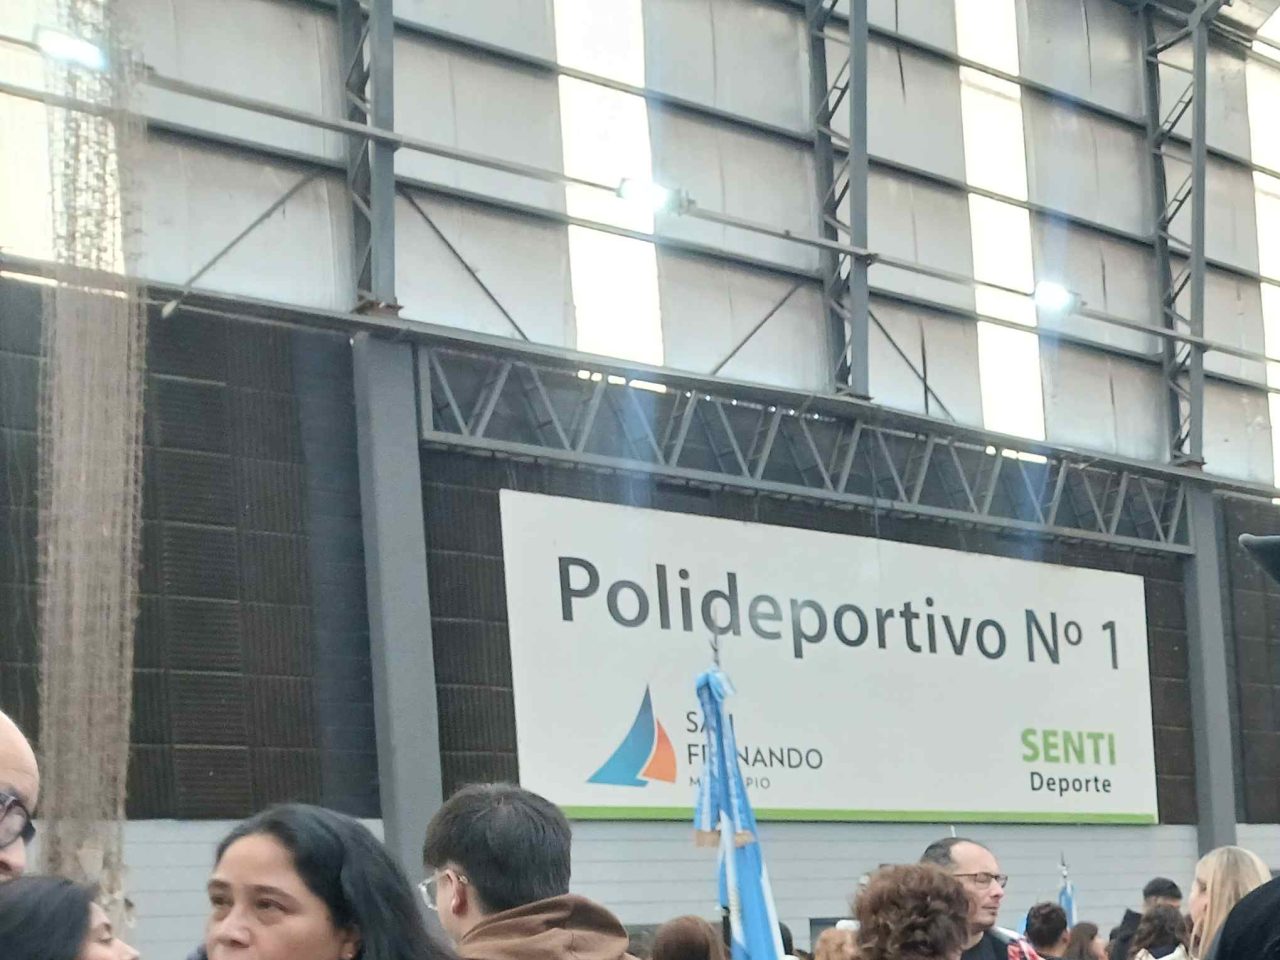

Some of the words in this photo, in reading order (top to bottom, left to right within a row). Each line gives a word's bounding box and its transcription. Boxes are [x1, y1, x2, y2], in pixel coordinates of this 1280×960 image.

[557, 555, 1007, 660] Polideportivo
[1101, 620, 1120, 669] 1
[687, 743, 823, 770] FNANDO
[1021, 728, 1117, 766] SENTI
[1029, 770, 1112, 797] Deporte
